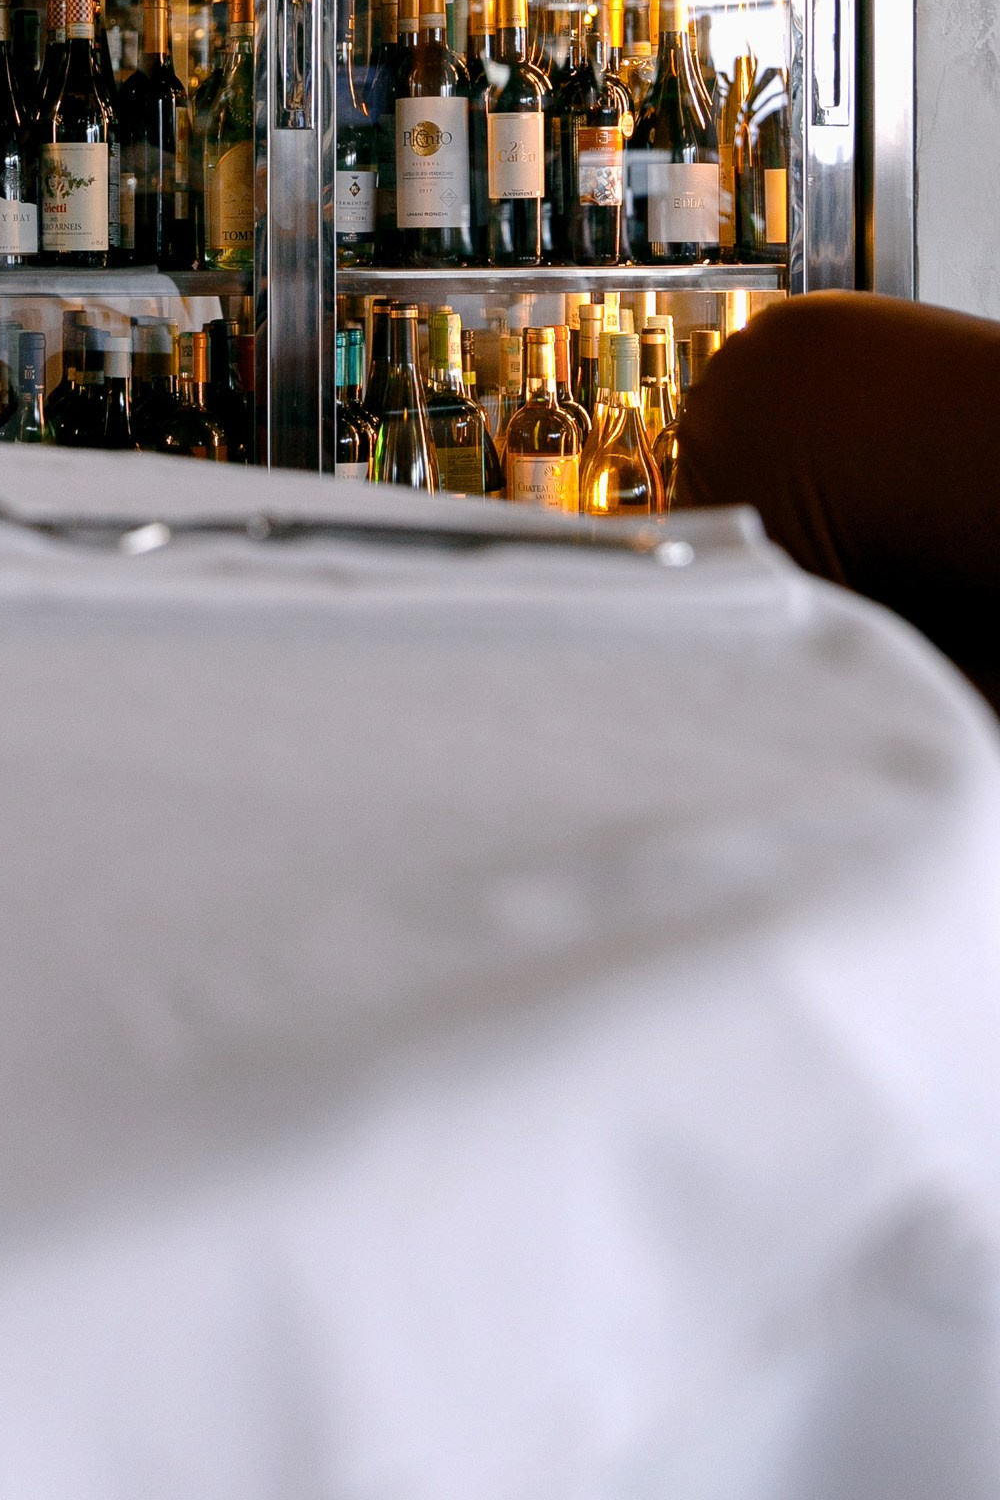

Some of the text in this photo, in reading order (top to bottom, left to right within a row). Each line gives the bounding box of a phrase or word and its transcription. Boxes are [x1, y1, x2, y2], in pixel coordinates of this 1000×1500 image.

[673, 197, 705, 209] EDDA
[13, 213, 31, 222] BAY
[55, 222, 82, 231] ARNEIS
[222, 231, 253, 242] TOMM
